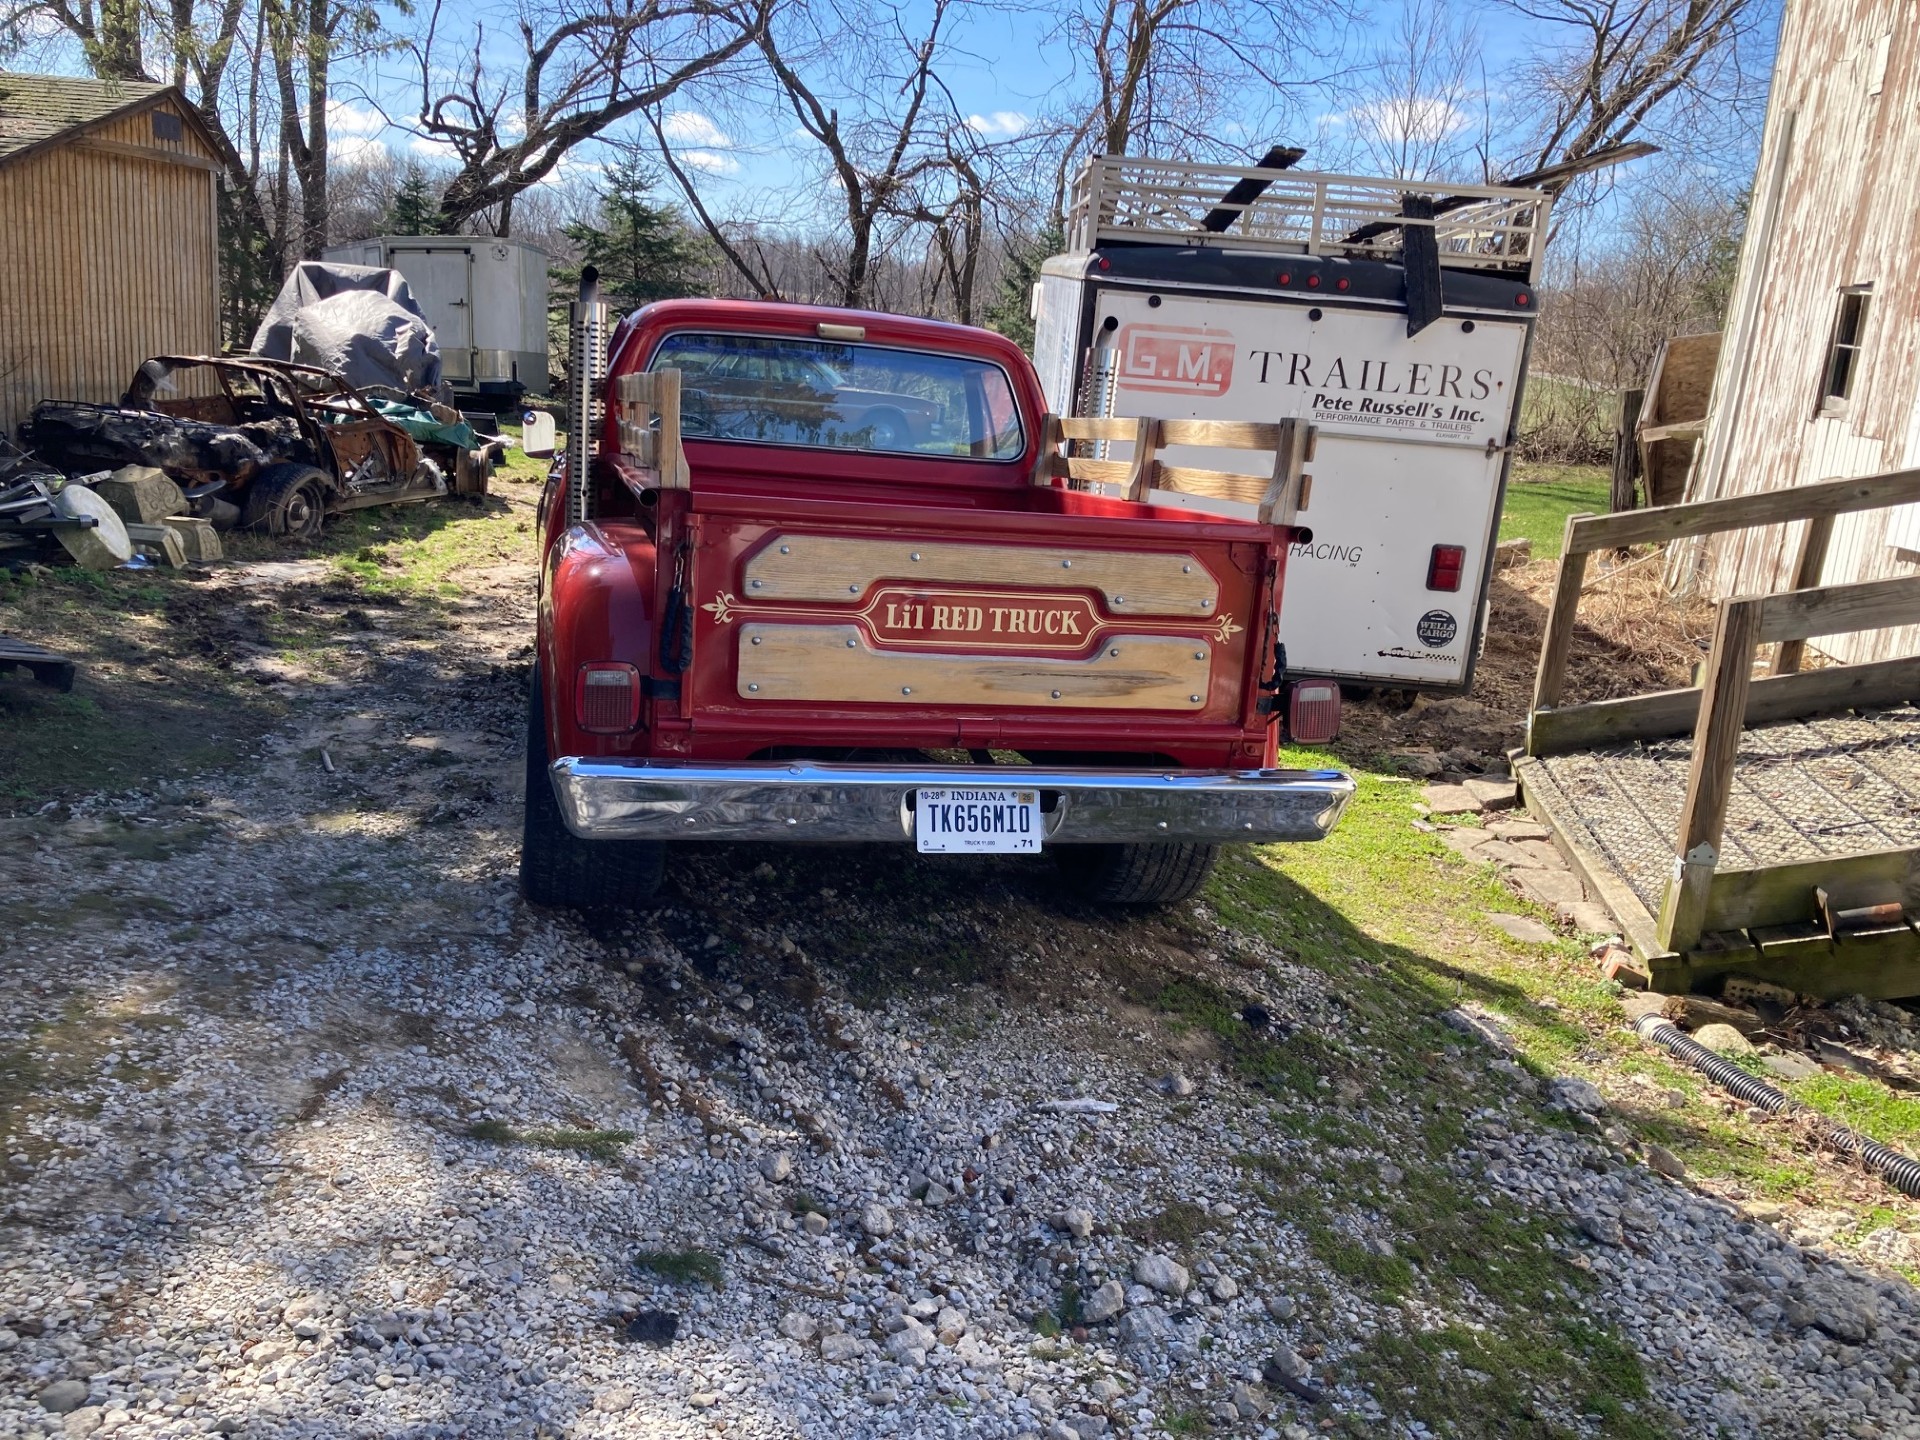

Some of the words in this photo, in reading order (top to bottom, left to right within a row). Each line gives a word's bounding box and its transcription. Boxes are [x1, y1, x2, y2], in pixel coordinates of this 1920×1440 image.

[1249, 350, 1492, 400] TRAILERS
[1311, 393, 1353, 411] Pete
[1359, 397, 1443, 419] Russell's
[1450, 405, 1486, 423] Inc.
[1315, 412, 1381, 425] PERFORMANCE
[1386, 418, 1415, 428] PARTS
[1431, 421, 1473, 432] TRAILERS
[1289, 542, 1363, 562] RACING
[885, 603, 924, 629] Li'l
[930, 605, 983, 631] RED
[989, 608, 1082, 635] TRUCK
[1420, 621, 1456, 631] WELLS
[1419, 629, 1454, 638] CARGO
[920, 791, 940, 800] 10-28
[951, 791, 1006, 801] INDIANA
[1021, 839, 1033, 847] 71
